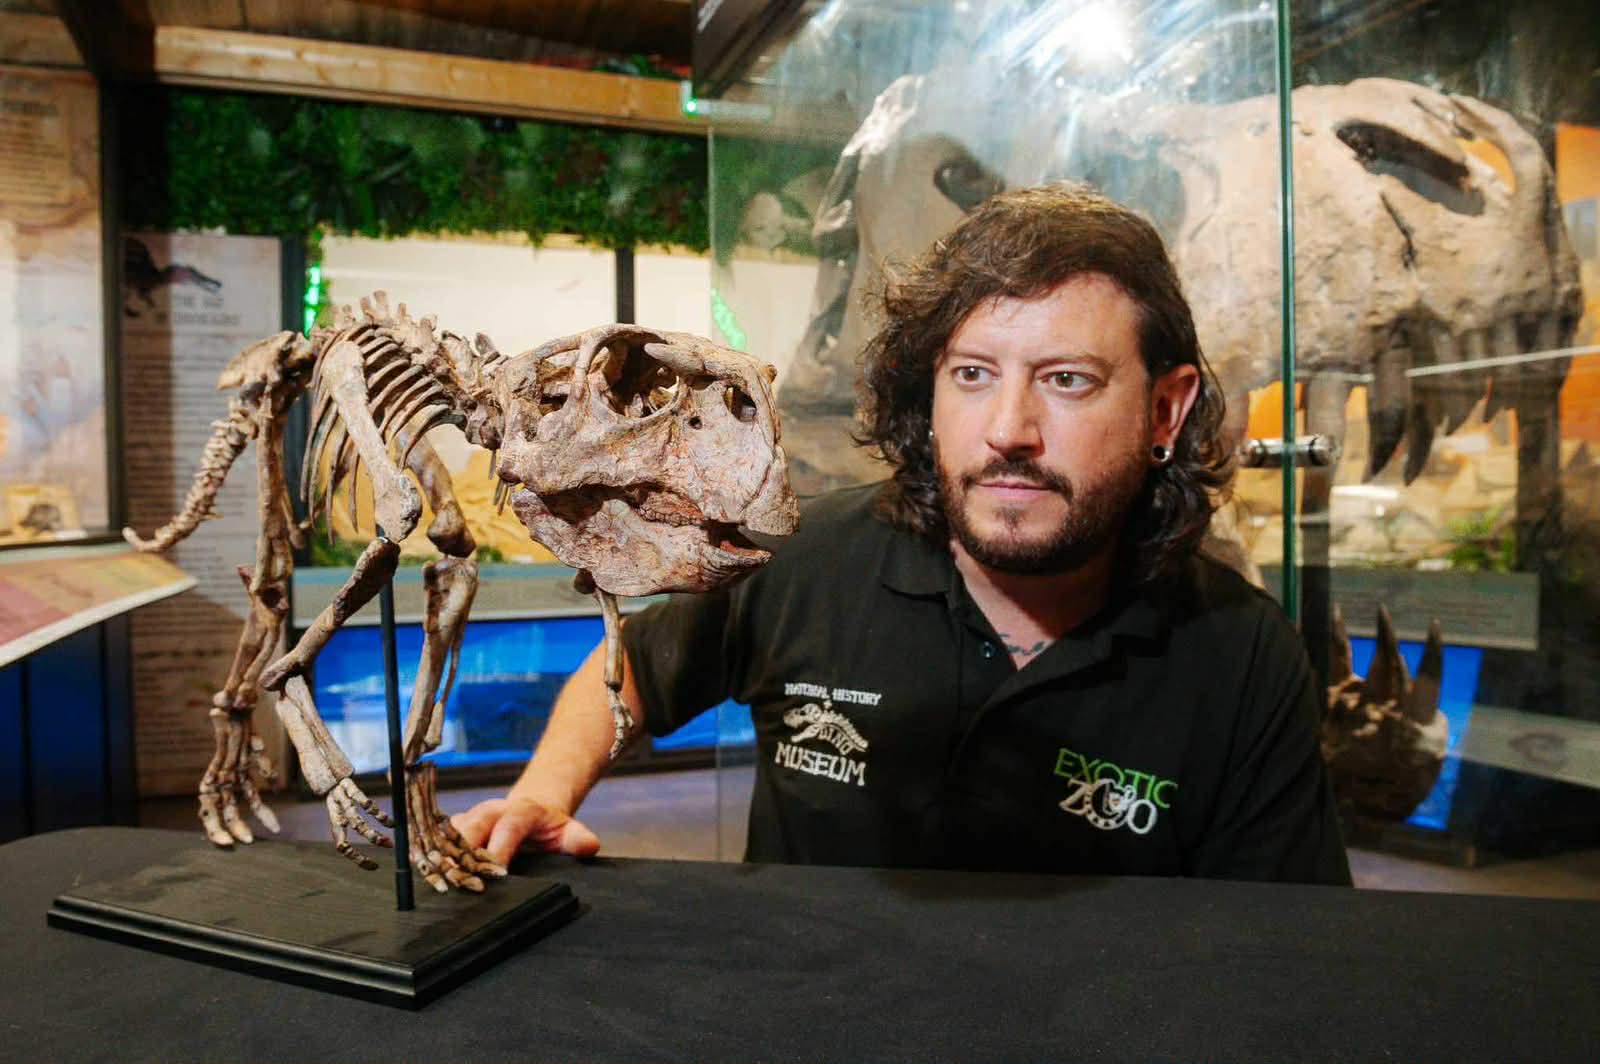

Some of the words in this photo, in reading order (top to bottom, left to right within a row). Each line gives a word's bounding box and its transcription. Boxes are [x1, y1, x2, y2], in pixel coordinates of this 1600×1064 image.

[832, 688, 882, 706] HISTORY
[775, 741, 866, 786] MUSEUM
[1054, 748, 1177, 807] EXOTIC
[1059, 778, 1158, 834] ZOO
